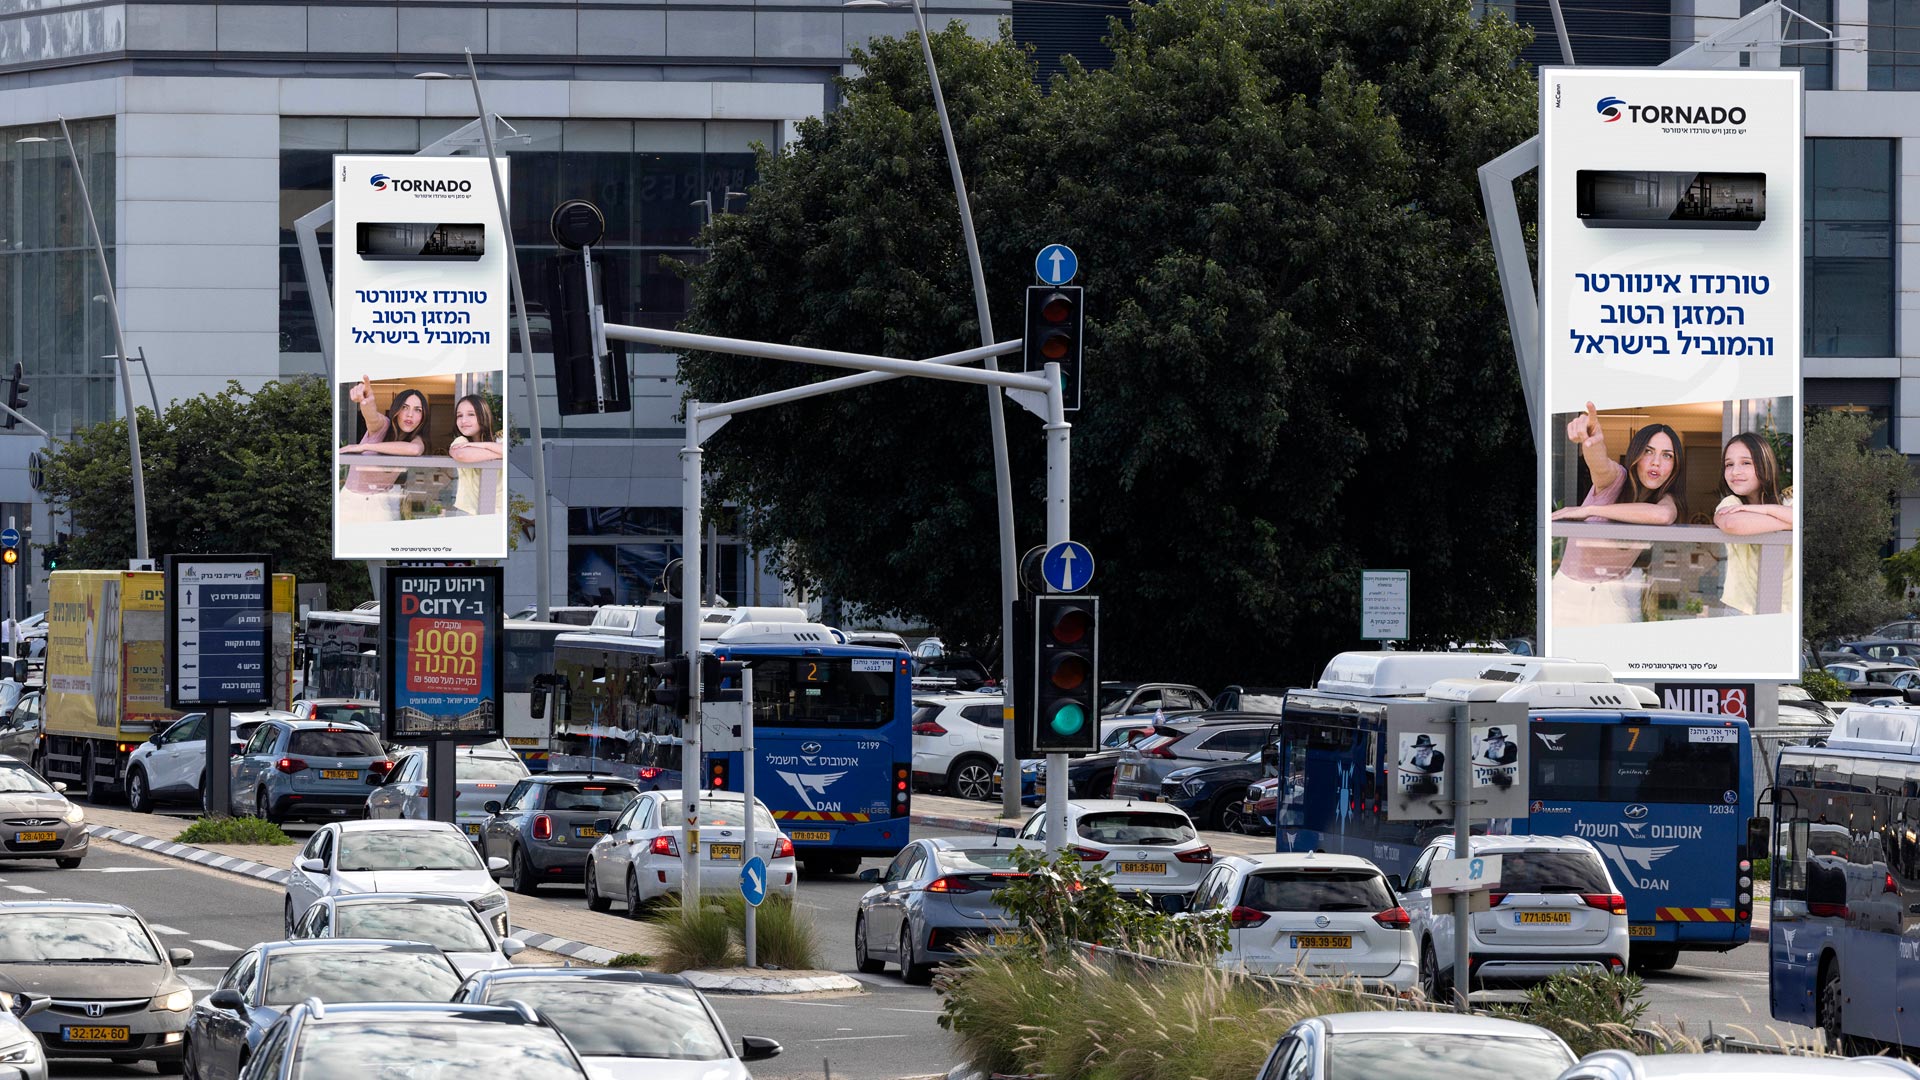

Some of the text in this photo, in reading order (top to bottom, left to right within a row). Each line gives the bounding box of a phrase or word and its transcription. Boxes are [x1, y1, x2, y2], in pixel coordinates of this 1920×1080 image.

[1628, 104, 1747, 126] TORNADO
[1723, 128, 1737, 136] מזגן
[391, 179, 472, 192] TORNADO
[1575, 273, 1770, 295] טורנדו אינוורטר
[355, 290, 488, 304] טורנדו אינוורטר
[372, 310, 471, 327] המזגן הטוב
[1600, 304, 1745, 329] המזגן הטוב
[351, 326, 490, 344] והמוביל בישראל
[1570, 328, 1774, 356] והמוביל בישראל
[200, 572, 213, 580] ברק
[402, 578, 485, 596] ריהוט קונים
[210, 593, 220, 602] כץ
[238, 616, 246, 625] גן
[434, 620, 462, 630] ומקבלים
[224, 640, 244, 649] תקווה
[414, 628, 477, 656] 1000
[132, 666, 158, 674] ביצים
[415, 653, 477, 676] מתנה
[1688, 662, 1703, 670] סקר
[807, 662, 817, 681] 2
[423, 676, 440, 684] 5000
[440, 676, 455, 684] מעל
[455, 677, 478, 687] בקנייה
[446, 696, 463, 704] ישראל
[463, 696, 479, 704] פארק
[1627, 727, 1640, 752] 7
[857, 741, 880, 750] 12199
[766, 753, 859, 767] אוטובוס חשמלי
[816, 801, 841, 812] DAN
[859, 807, 890, 815] HIGER
[1708, 804, 1735, 815] 12034
[1574, 819, 1703, 840] אוטובוס חשמלי
[1640, 877, 1670, 891] DAN
